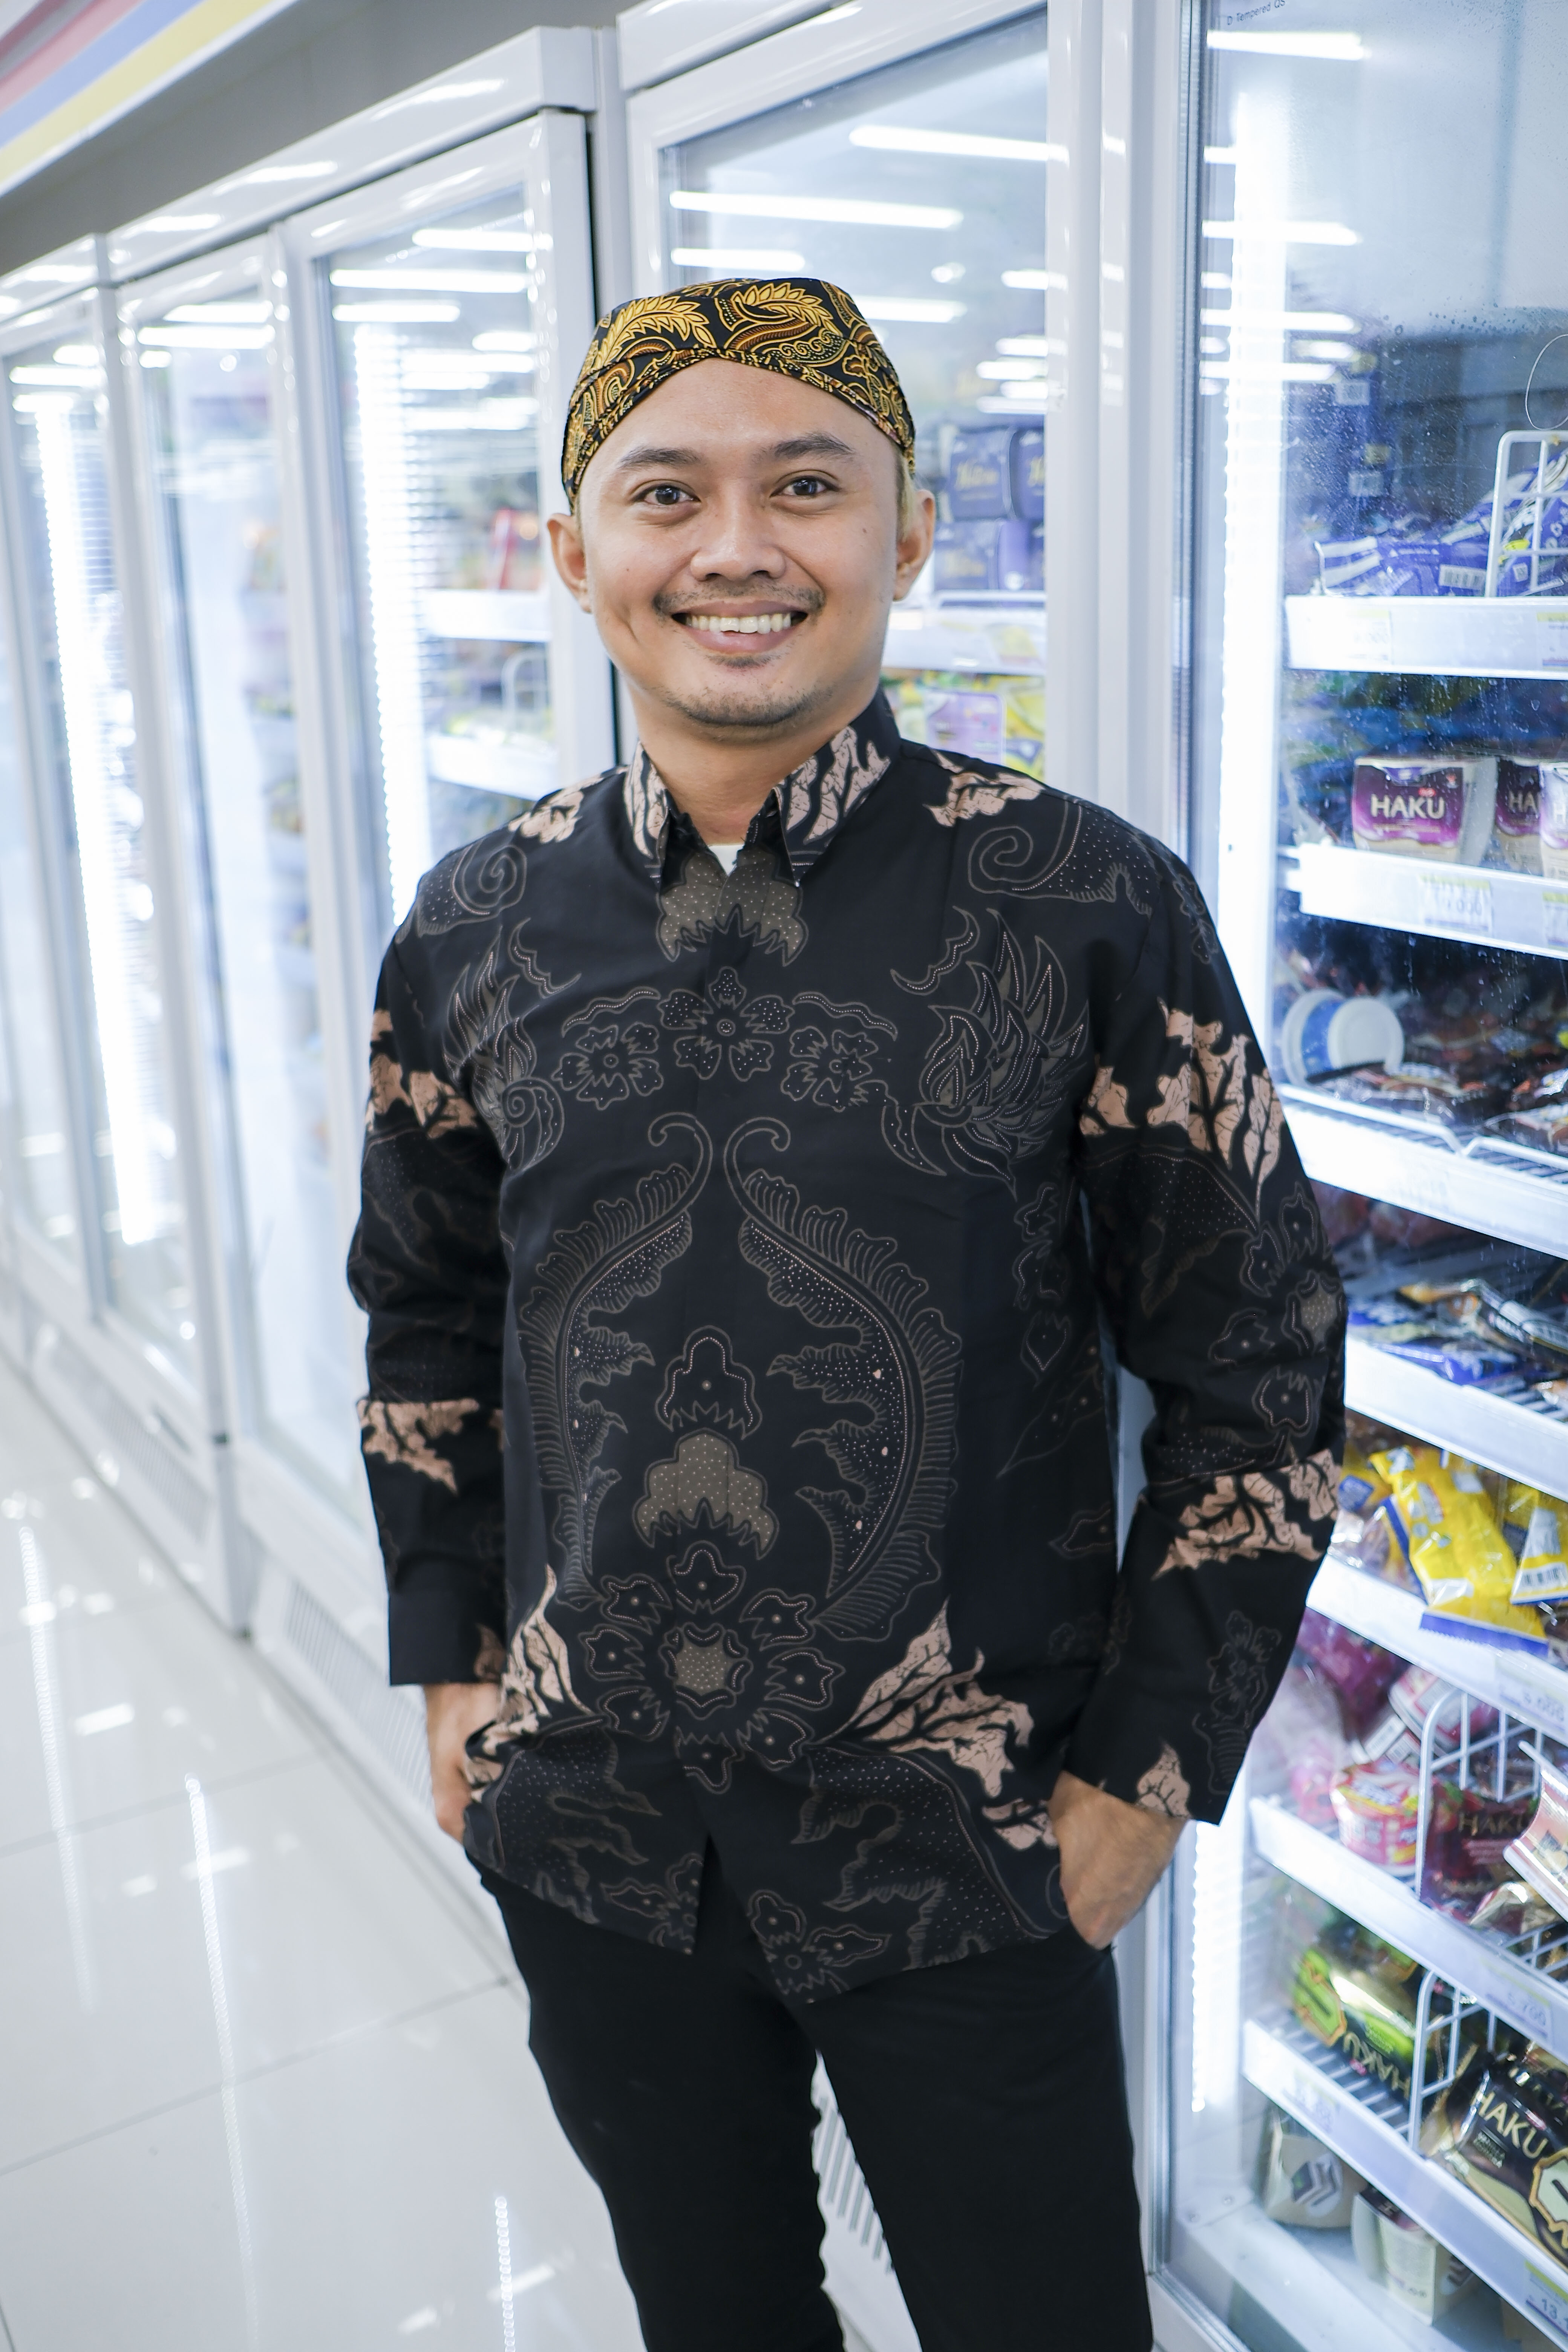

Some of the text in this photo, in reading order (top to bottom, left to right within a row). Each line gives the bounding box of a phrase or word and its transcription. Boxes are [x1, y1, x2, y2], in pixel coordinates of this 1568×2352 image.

[1237, 2, 1271, 21] Tempered
[1370, 794, 1445, 819] HAKU
[1508, 791, 1540, 814] HA
[1472, 2091, 1548, 2159] HAKU
